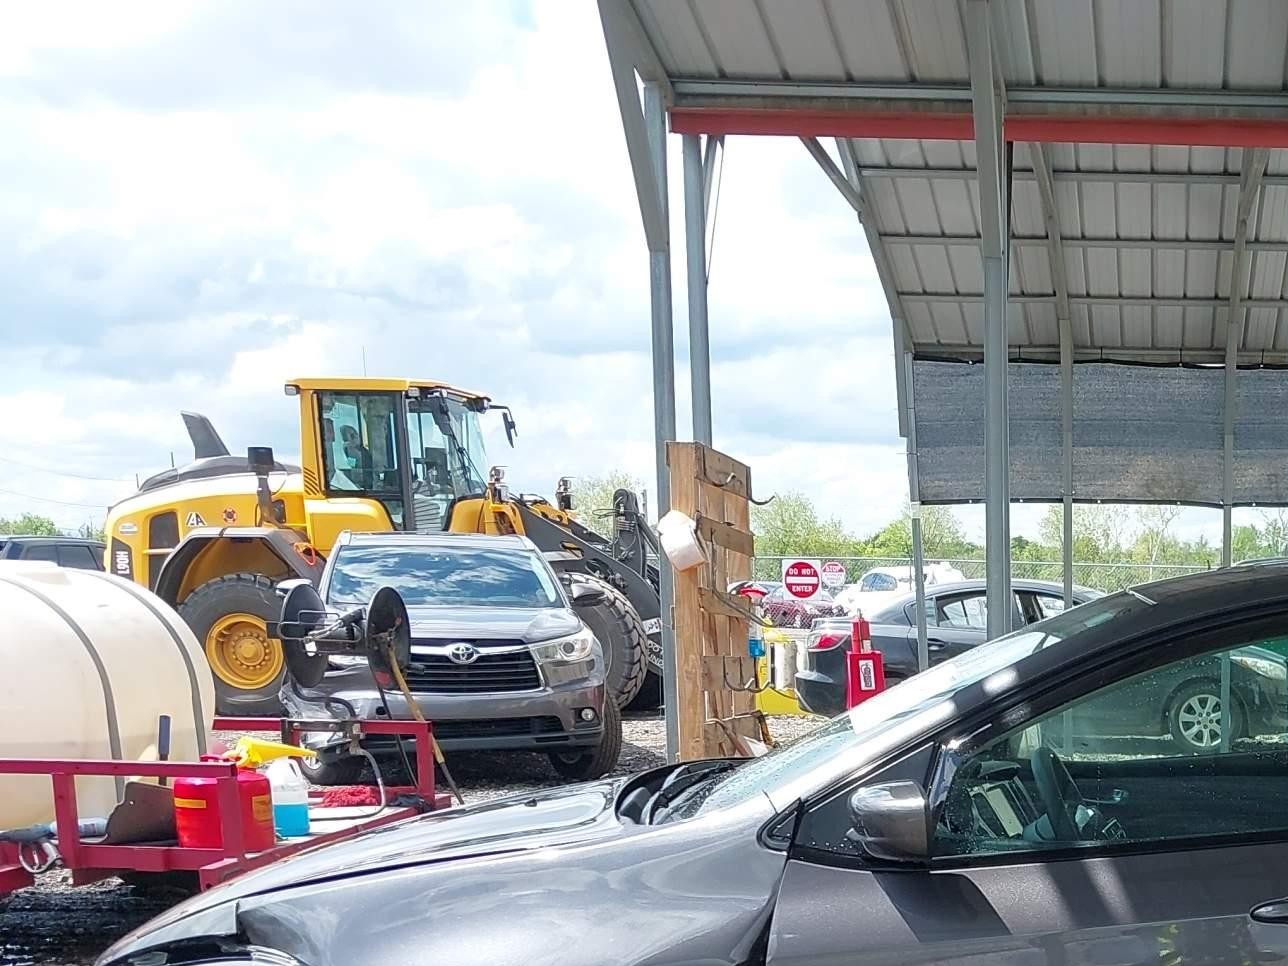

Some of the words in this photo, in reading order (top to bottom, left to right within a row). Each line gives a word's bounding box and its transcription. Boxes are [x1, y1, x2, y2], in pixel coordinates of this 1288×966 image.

[115, 551, 130, 574] L90H
[788, 567, 798, 575] DO
[801, 568, 815, 576] NOT
[791, 585, 813, 593] ENTER
